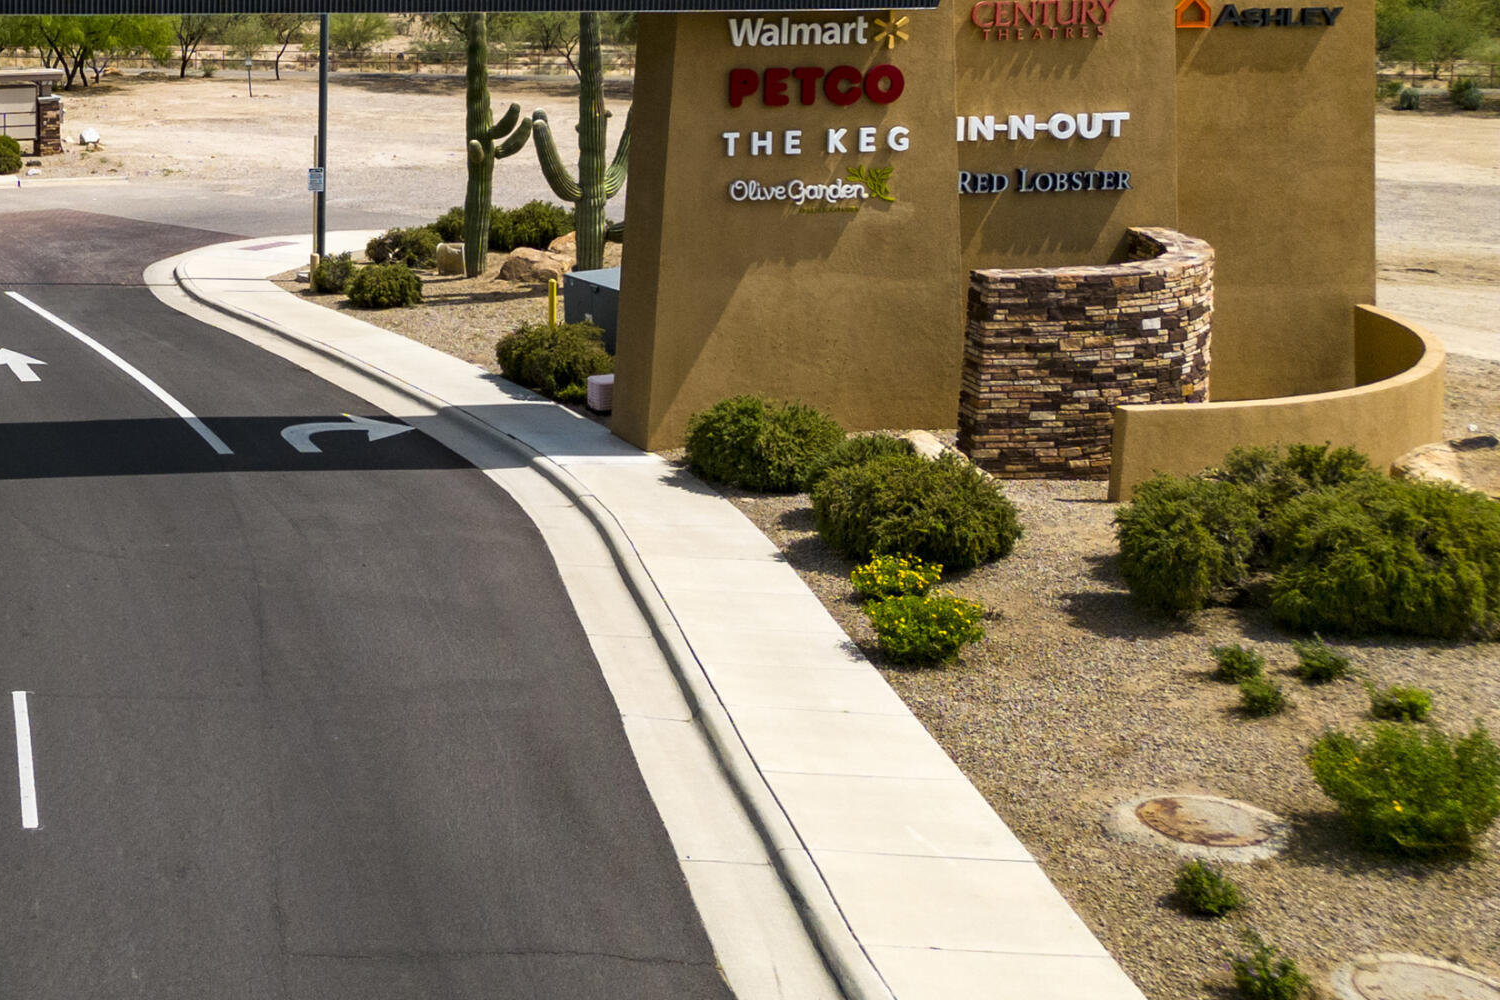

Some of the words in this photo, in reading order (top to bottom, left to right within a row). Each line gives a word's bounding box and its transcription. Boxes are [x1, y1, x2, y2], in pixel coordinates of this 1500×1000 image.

[1214, 3, 1343, 28] ASHLEY
[728, 16, 869, 47] Walmart
[983, 26, 1106, 41] THEATRES
[728, 64, 905, 108] PETCO
[722, 130, 802, 157] THE
[827, 126, 910, 154] KEG
[956, 111, 1130, 142] IN-N-OUT
[958, 169, 1009, 195] RED
[1016, 167, 1133, 193] LOBSTER
